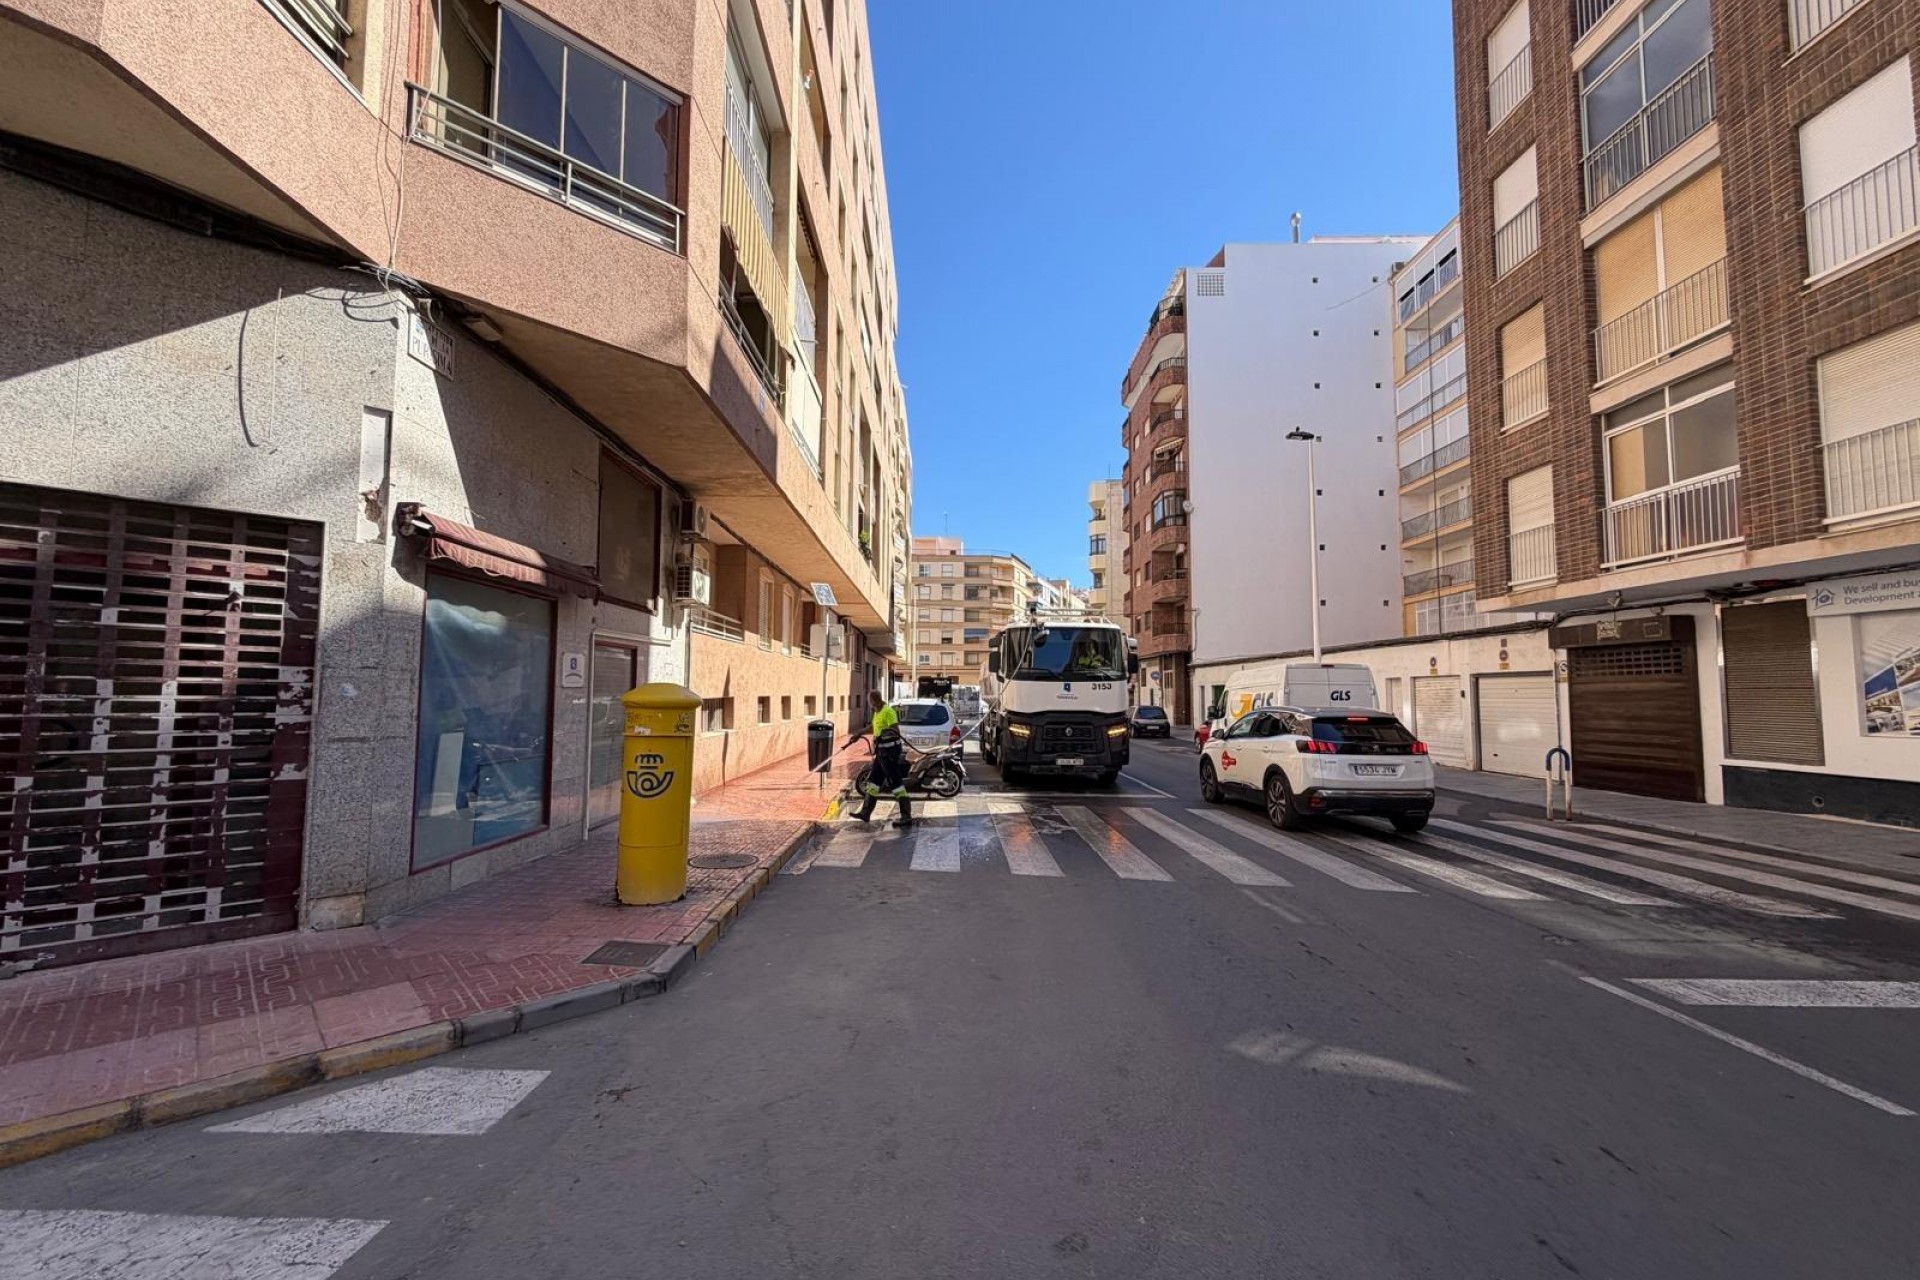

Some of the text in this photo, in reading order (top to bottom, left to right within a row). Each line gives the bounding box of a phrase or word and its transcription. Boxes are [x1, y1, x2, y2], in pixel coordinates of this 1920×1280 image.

[1843, 585, 1859, 594] We
[1861, 583, 1878, 592] sell
[1880, 580, 1901, 590] and
[1844, 591, 1915, 604] Development
[1330, 690, 1351, 700] GLS
